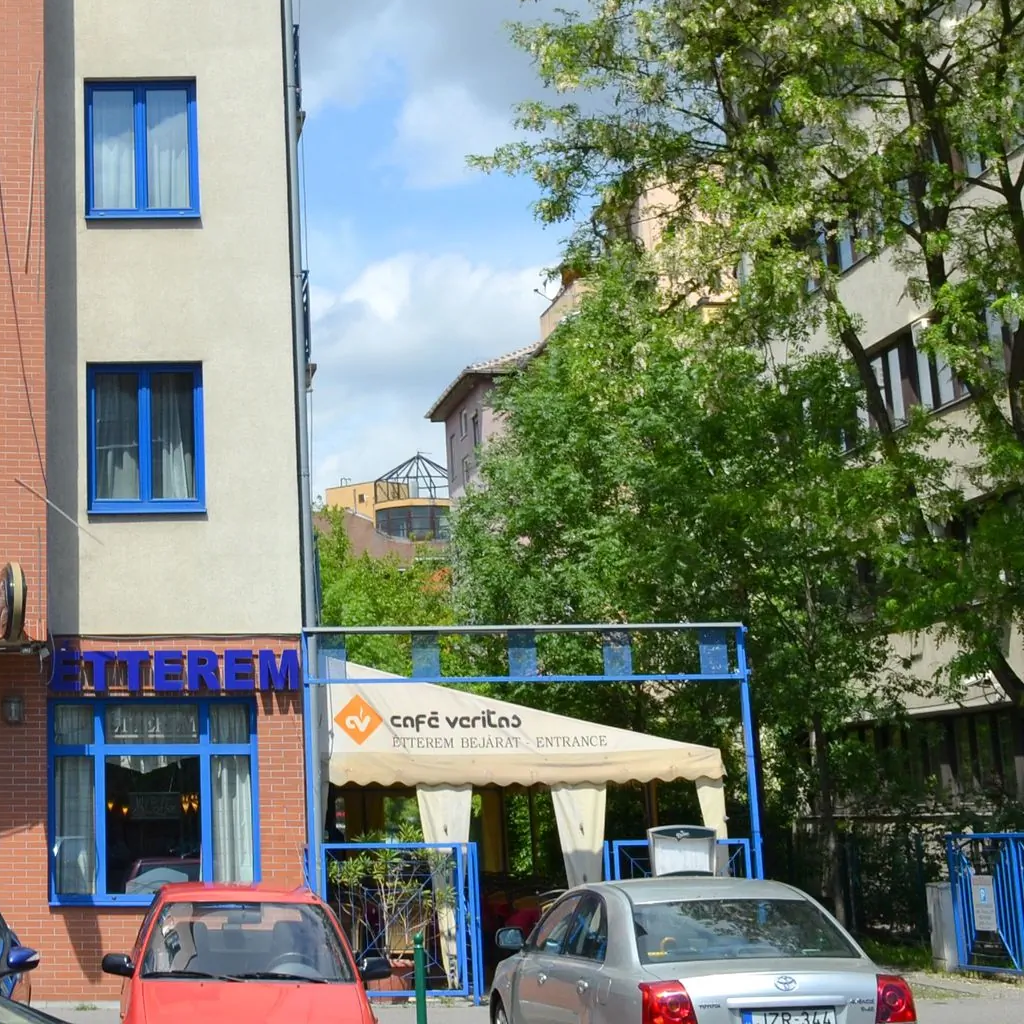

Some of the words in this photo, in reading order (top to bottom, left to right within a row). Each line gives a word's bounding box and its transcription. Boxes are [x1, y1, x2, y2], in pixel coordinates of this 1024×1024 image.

[445, 709, 522, 728] veritas
[461, 734, 521, 749] BEJÁRAT
[535, 735, 608, 748] ENTRANCE
